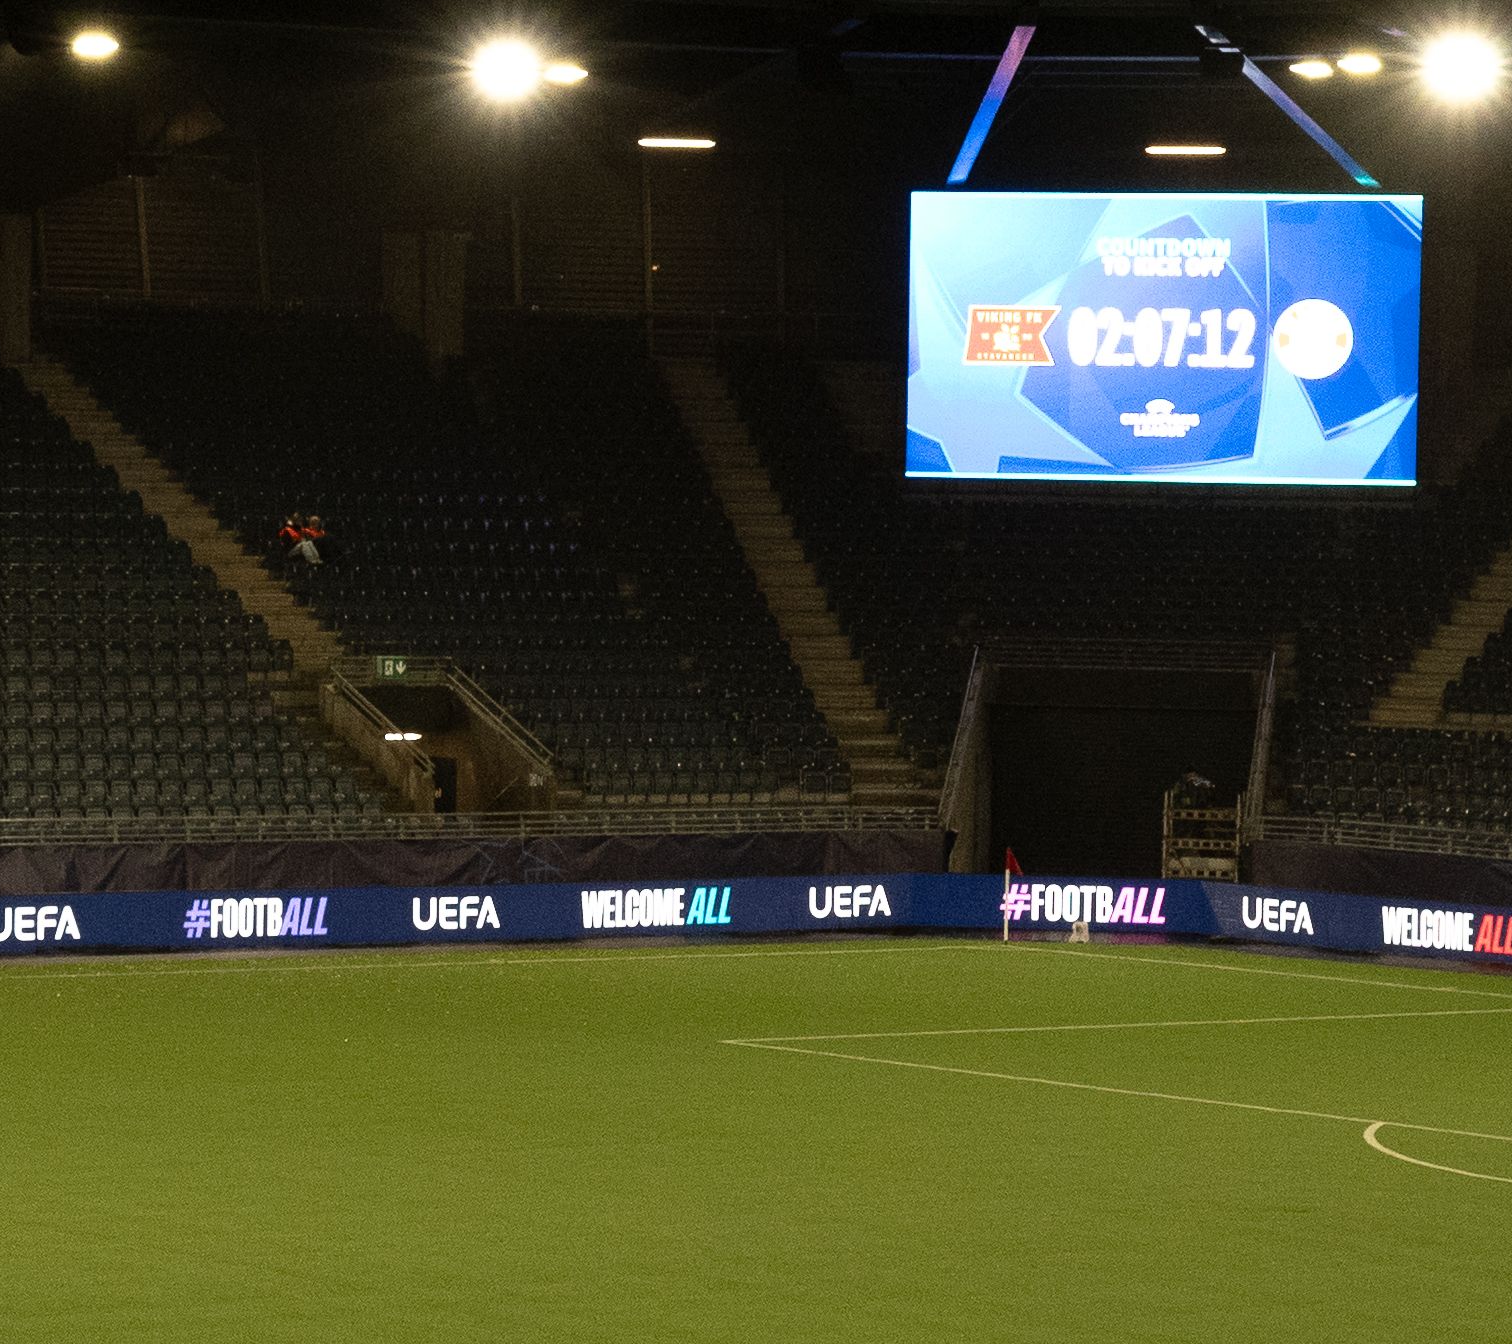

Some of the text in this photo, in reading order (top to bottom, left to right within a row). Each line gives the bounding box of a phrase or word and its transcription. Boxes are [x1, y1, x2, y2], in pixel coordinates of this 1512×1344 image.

[1097, 238, 1231, 256] COUNTDOWN
[1102, 256, 1130, 276] TO
[1068, 306, 1256, 368] 02:07:12
[184, 897, 329, 940] #FOOTBALL
[413, 896, 502, 932] UEFA
[582, 887, 732, 929] WELCOME ALL
[809, 885, 893, 920] UEFA
[999, 882, 1167, 926] #FOOTBALL
[1243, 896, 1315, 936] UEFA
[1383, 907, 1474, 952] WELCOME
